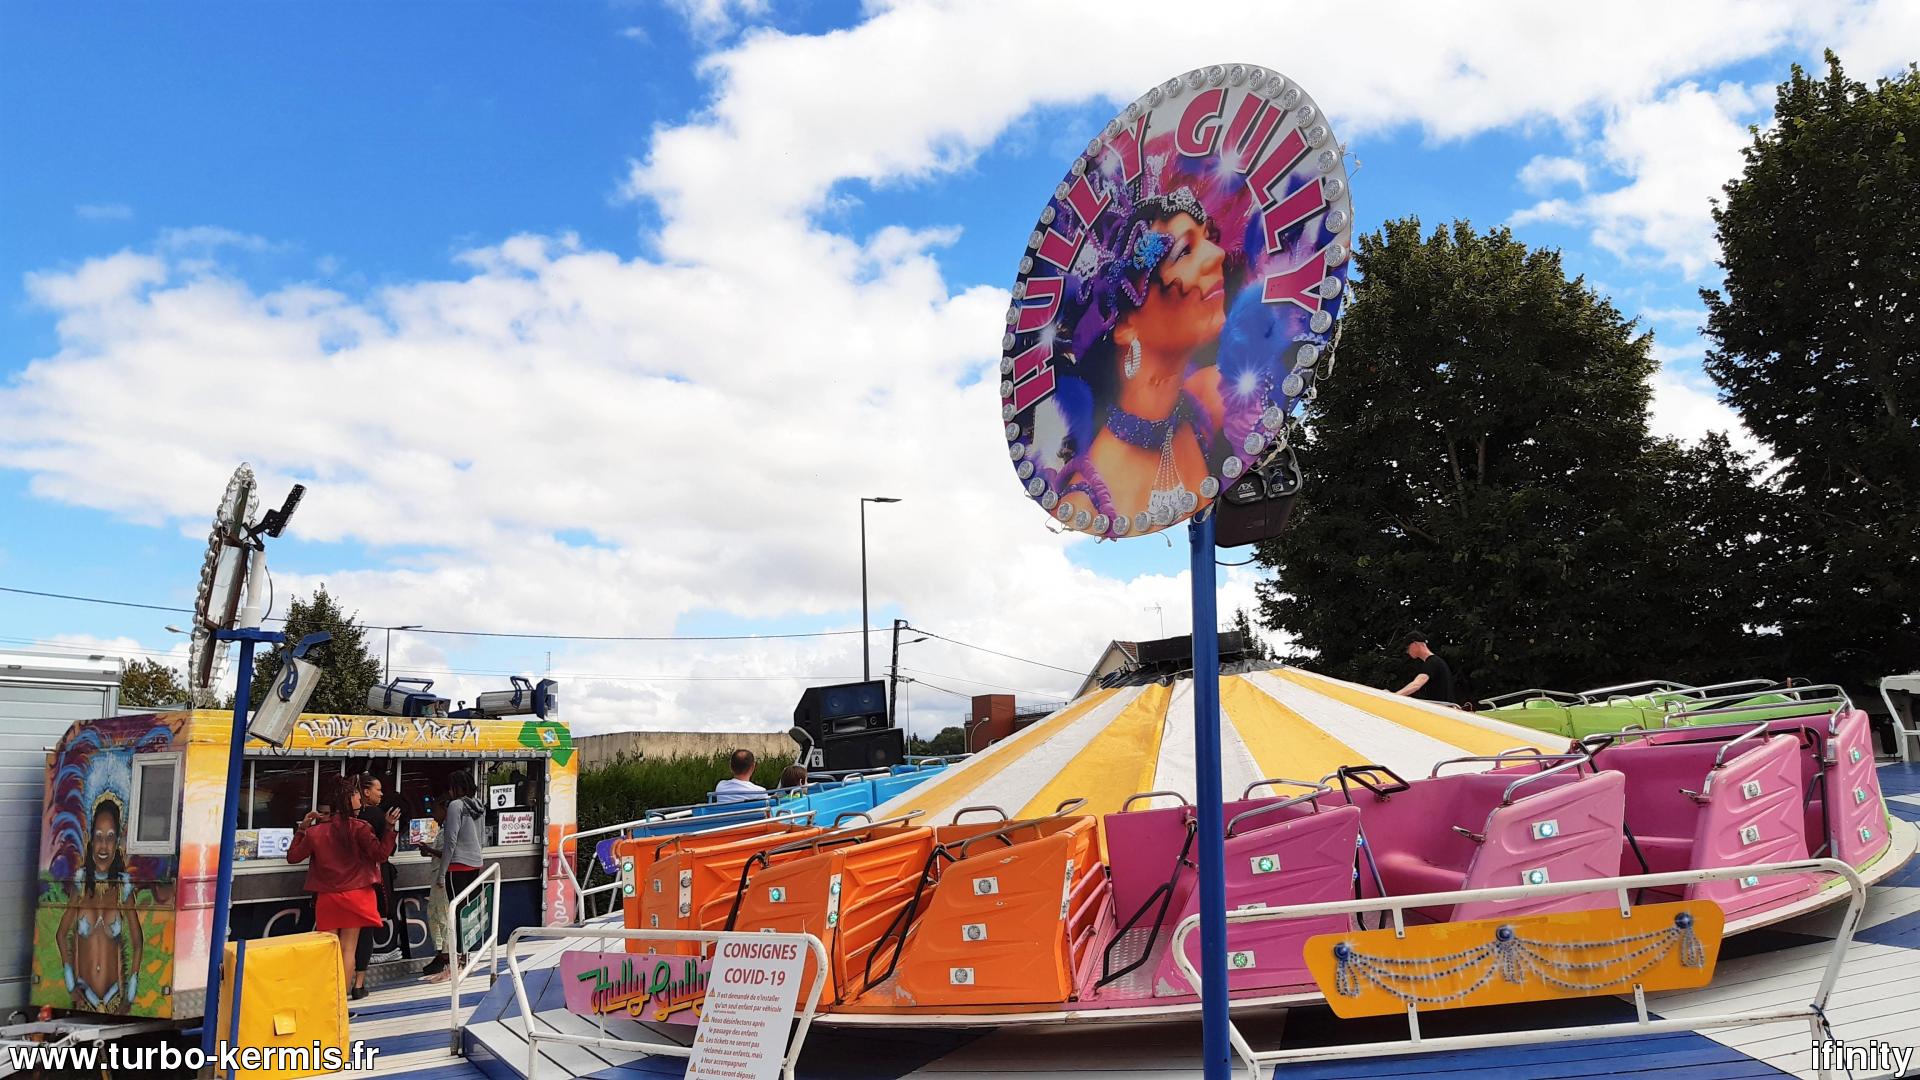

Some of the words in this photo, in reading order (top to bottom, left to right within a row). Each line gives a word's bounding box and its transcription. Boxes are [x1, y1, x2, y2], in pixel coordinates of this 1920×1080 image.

[1013, 110, 1152, 414] HULLY
[1174, 88, 1328, 314] GULLY
[723, 942, 798, 960] CONSIGNES
[724, 967, 786, 986] COVID-19
[576, 957, 651, 1017] Hully
[749, 993, 757, 1001] de
[728, 1002, 738, 1010] seul
[737, 1003, 753, 1011] enfant
[740, 1028, 759, 1037] enfants
[705, 1036, 714, 1044] Les
[713, 1036, 729, 1045] tickets
[735, 1040, 751, 1048] seront
[751, 1041, 760, 1049] pas
[751, 1051, 763, 1059] mais
[697, 1066, 705, 1074] Les
[705, 1066, 721, 1076] tickets
